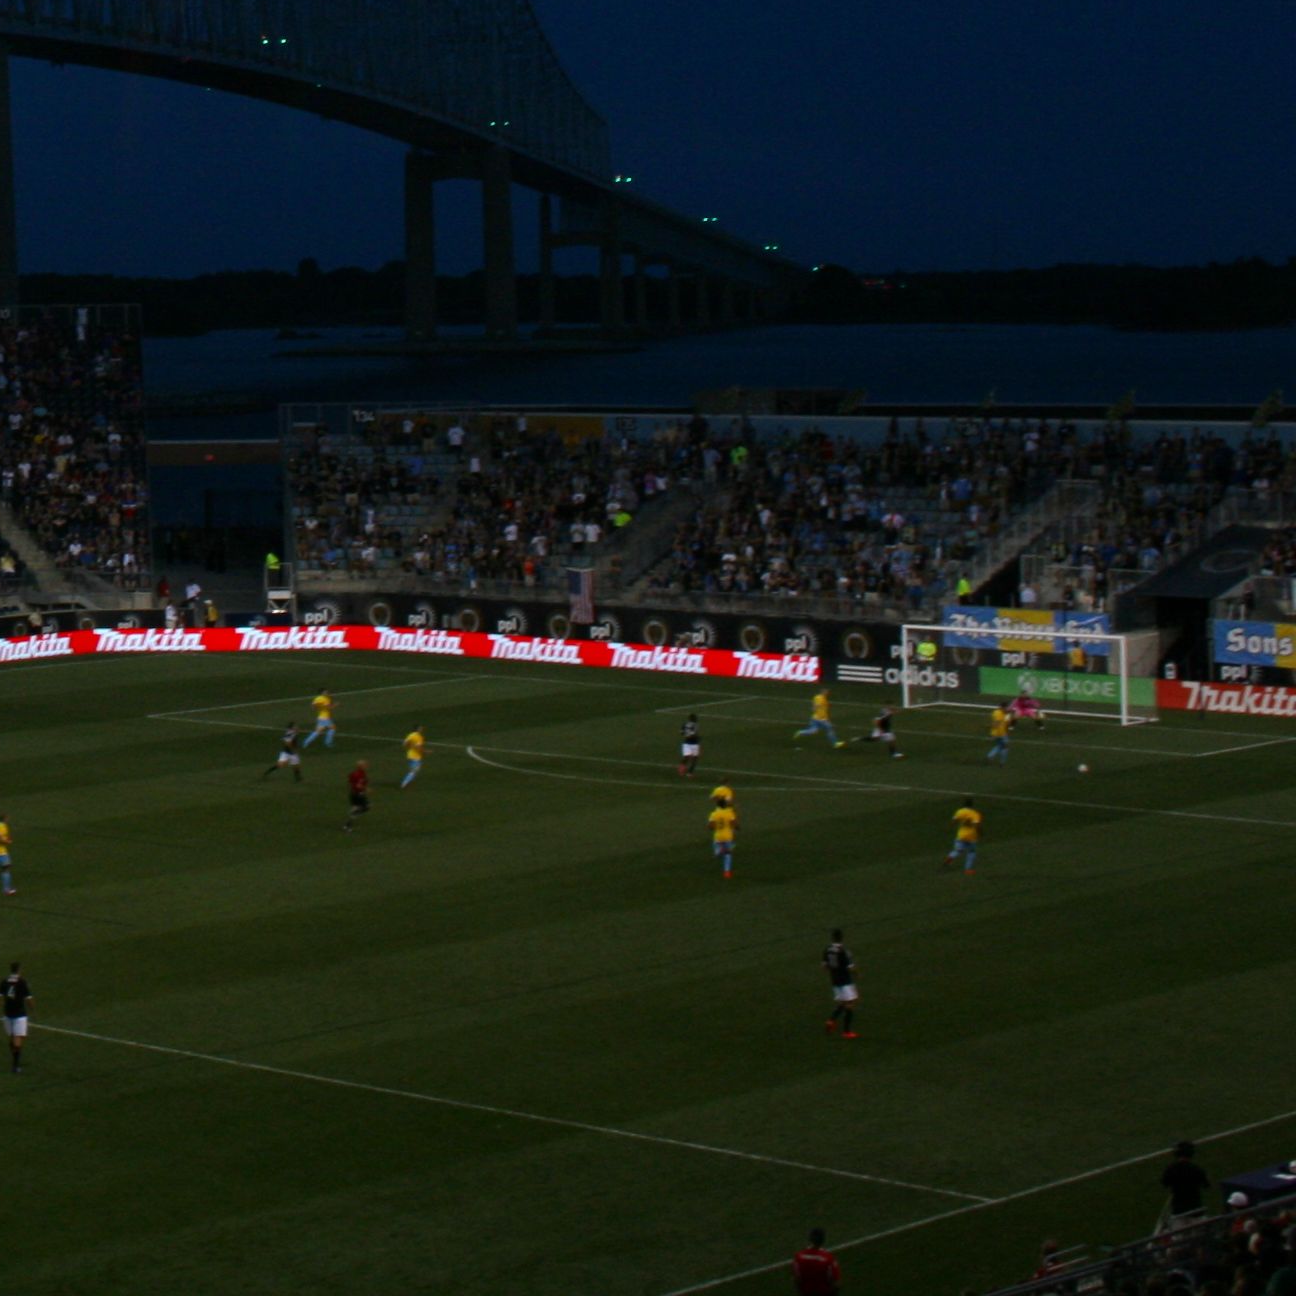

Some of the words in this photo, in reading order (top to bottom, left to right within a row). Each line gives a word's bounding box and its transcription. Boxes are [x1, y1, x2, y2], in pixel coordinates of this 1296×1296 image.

[305, 608, 328, 625] ppl
[93, 628, 205, 651] Makita
[236, 626, 348, 649] Makita
[375, 626, 463, 654] Makita
[488, 634, 582, 664] Makita
[1225, 627, 1294, 655] Sons
[608, 642, 706, 673] Makita
